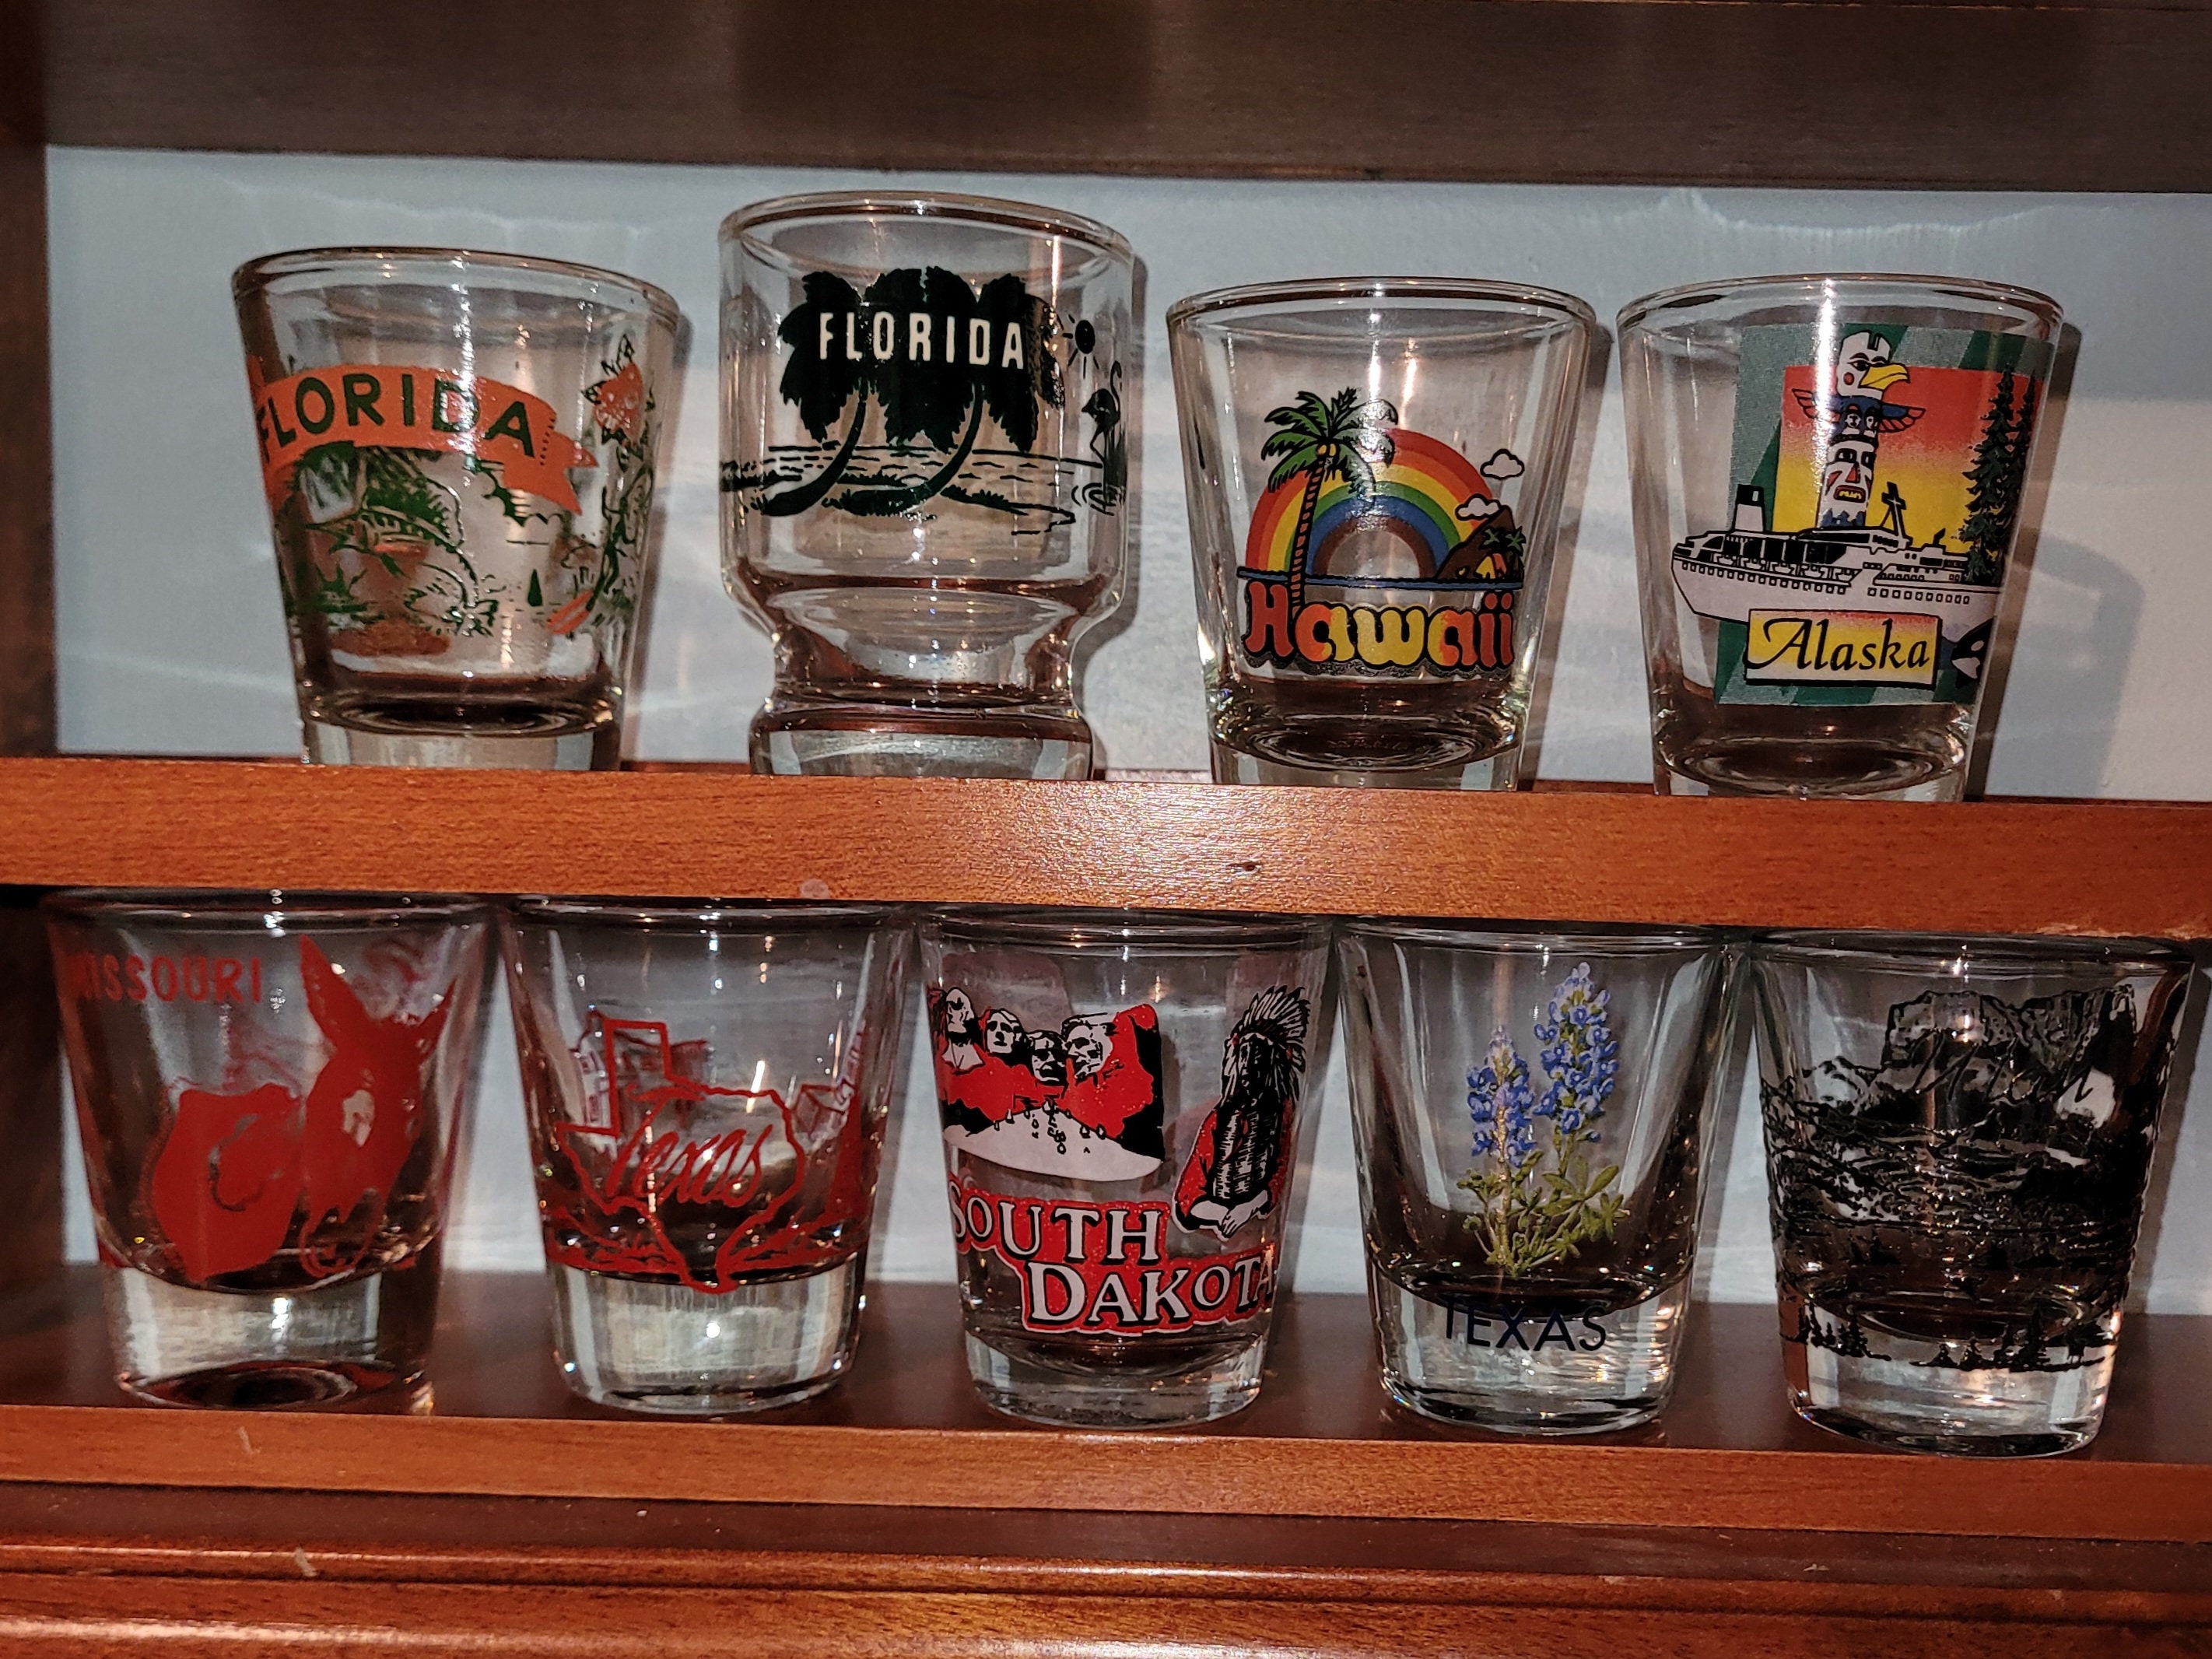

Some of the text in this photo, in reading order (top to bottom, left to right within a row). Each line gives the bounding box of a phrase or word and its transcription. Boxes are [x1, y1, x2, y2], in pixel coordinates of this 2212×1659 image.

[819, 311, 1025, 370] FLORIDA
[256, 373, 535, 464] FLORIDA
[1244, 580, 1515, 668] Hawaii
[1745, 617, 1931, 672] Alaska
[606, 1083, 773, 1208] Texas
[950, 1181, 1162, 1262] SOUTH
[1028, 1247, 1274, 1322] DAKOTA
[1443, 1296, 1607, 1352] TEXAS
